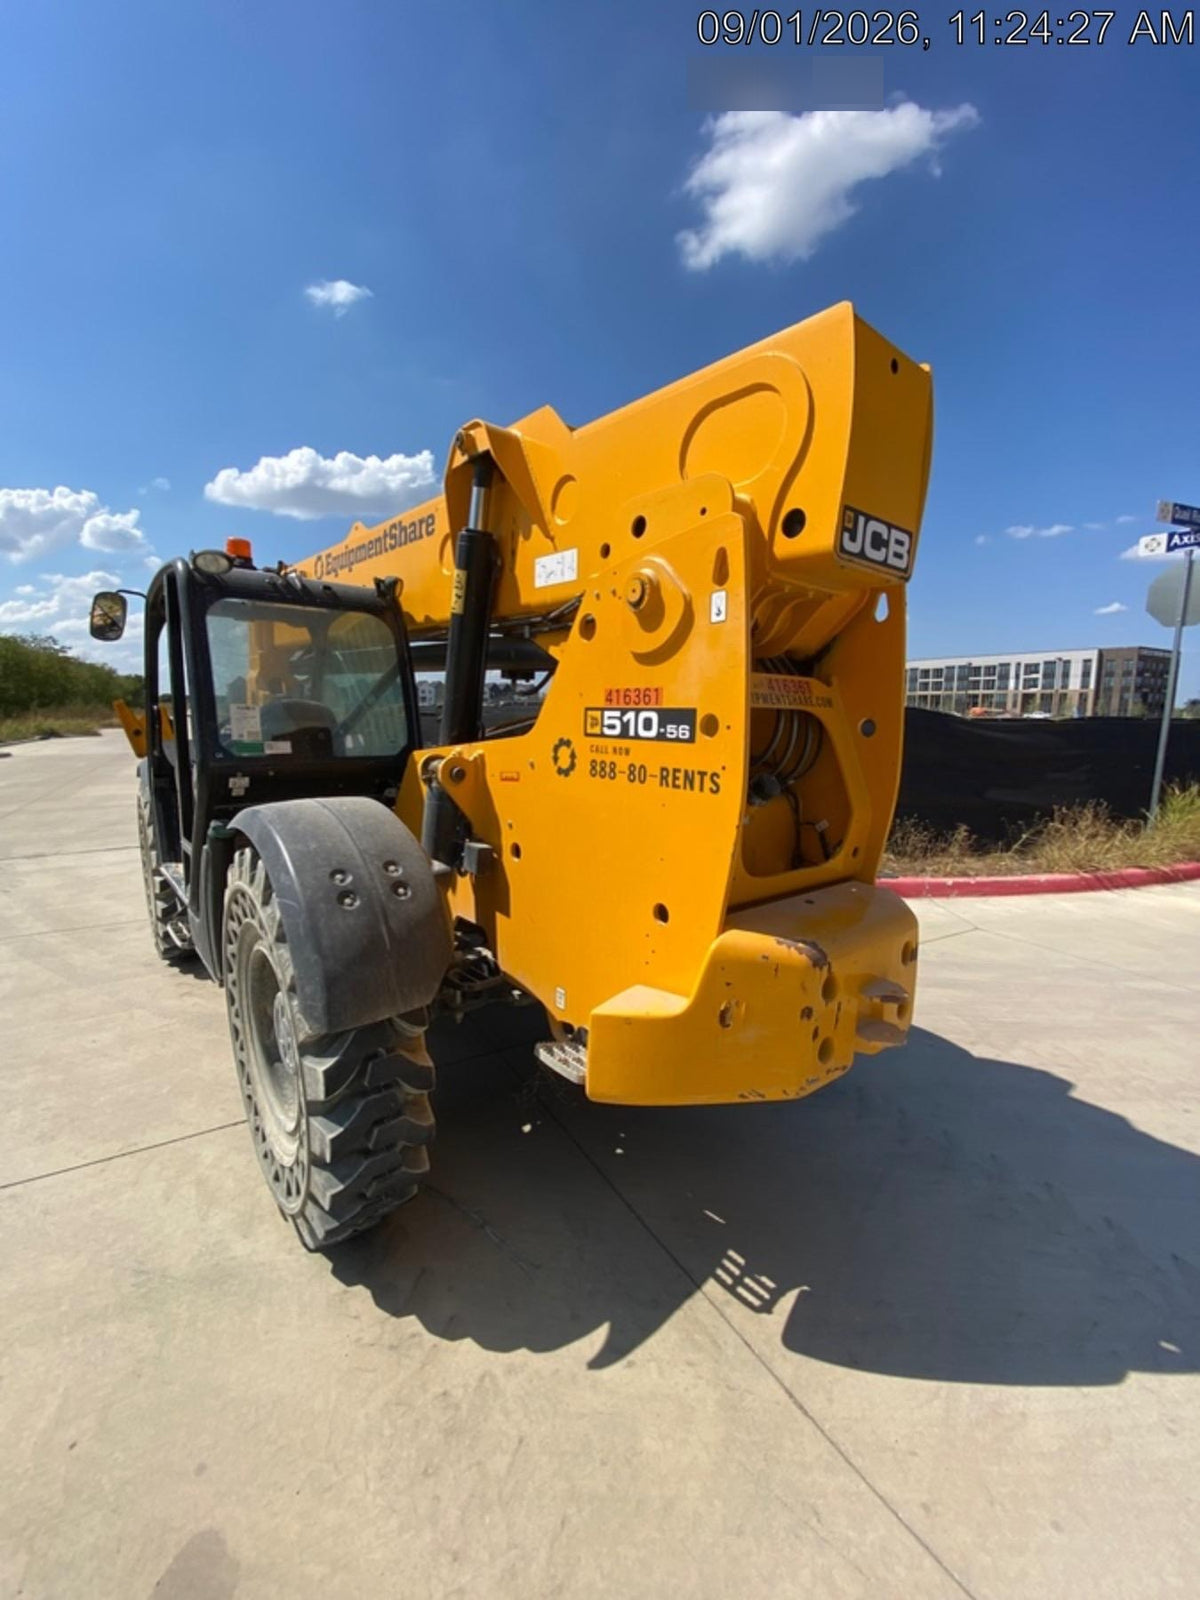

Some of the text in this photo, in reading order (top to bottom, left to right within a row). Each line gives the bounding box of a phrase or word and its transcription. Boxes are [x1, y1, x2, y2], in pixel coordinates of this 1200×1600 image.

[325, 513, 436, 577] EquipmentShare
[842, 514, 911, 570] JCB
[605, 687, 661, 706] 416361
[602, 710, 690, 739] 510-56
[590, 744, 631, 757] CALL NOW
[589, 758, 721, 795] 888-80-RENTS
